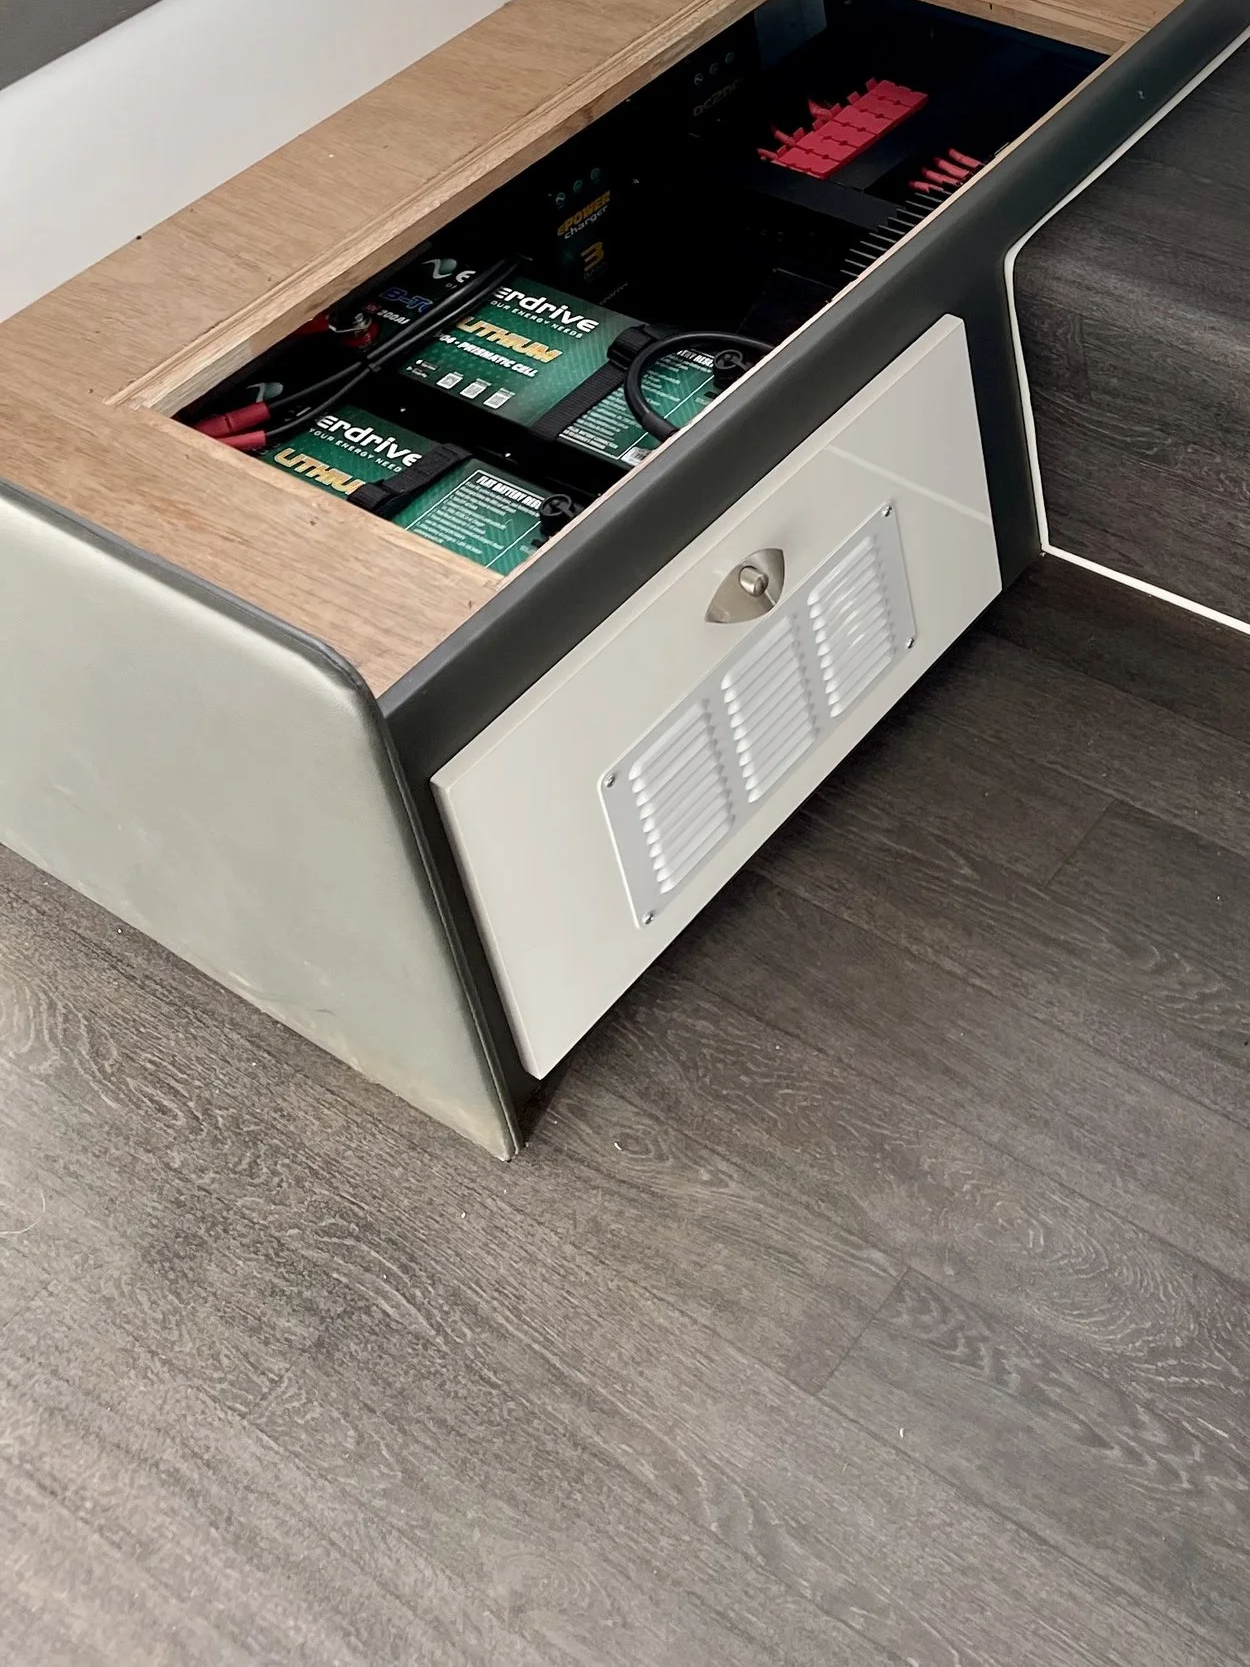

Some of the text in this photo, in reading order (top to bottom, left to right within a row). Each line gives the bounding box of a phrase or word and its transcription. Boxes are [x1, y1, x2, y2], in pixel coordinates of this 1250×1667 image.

[563, 204, 609, 240] charger
[580, 241, 605, 272] 3
[490, 300, 509, 310] OUR
[511, 361, 538, 377] CELL
[309, 428, 403, 473] YOUR ENERGY NEED
[274, 447, 366, 496] LITHIU
[476, 476, 494, 489] FLAT
[492, 481, 527, 502] BATTERY
